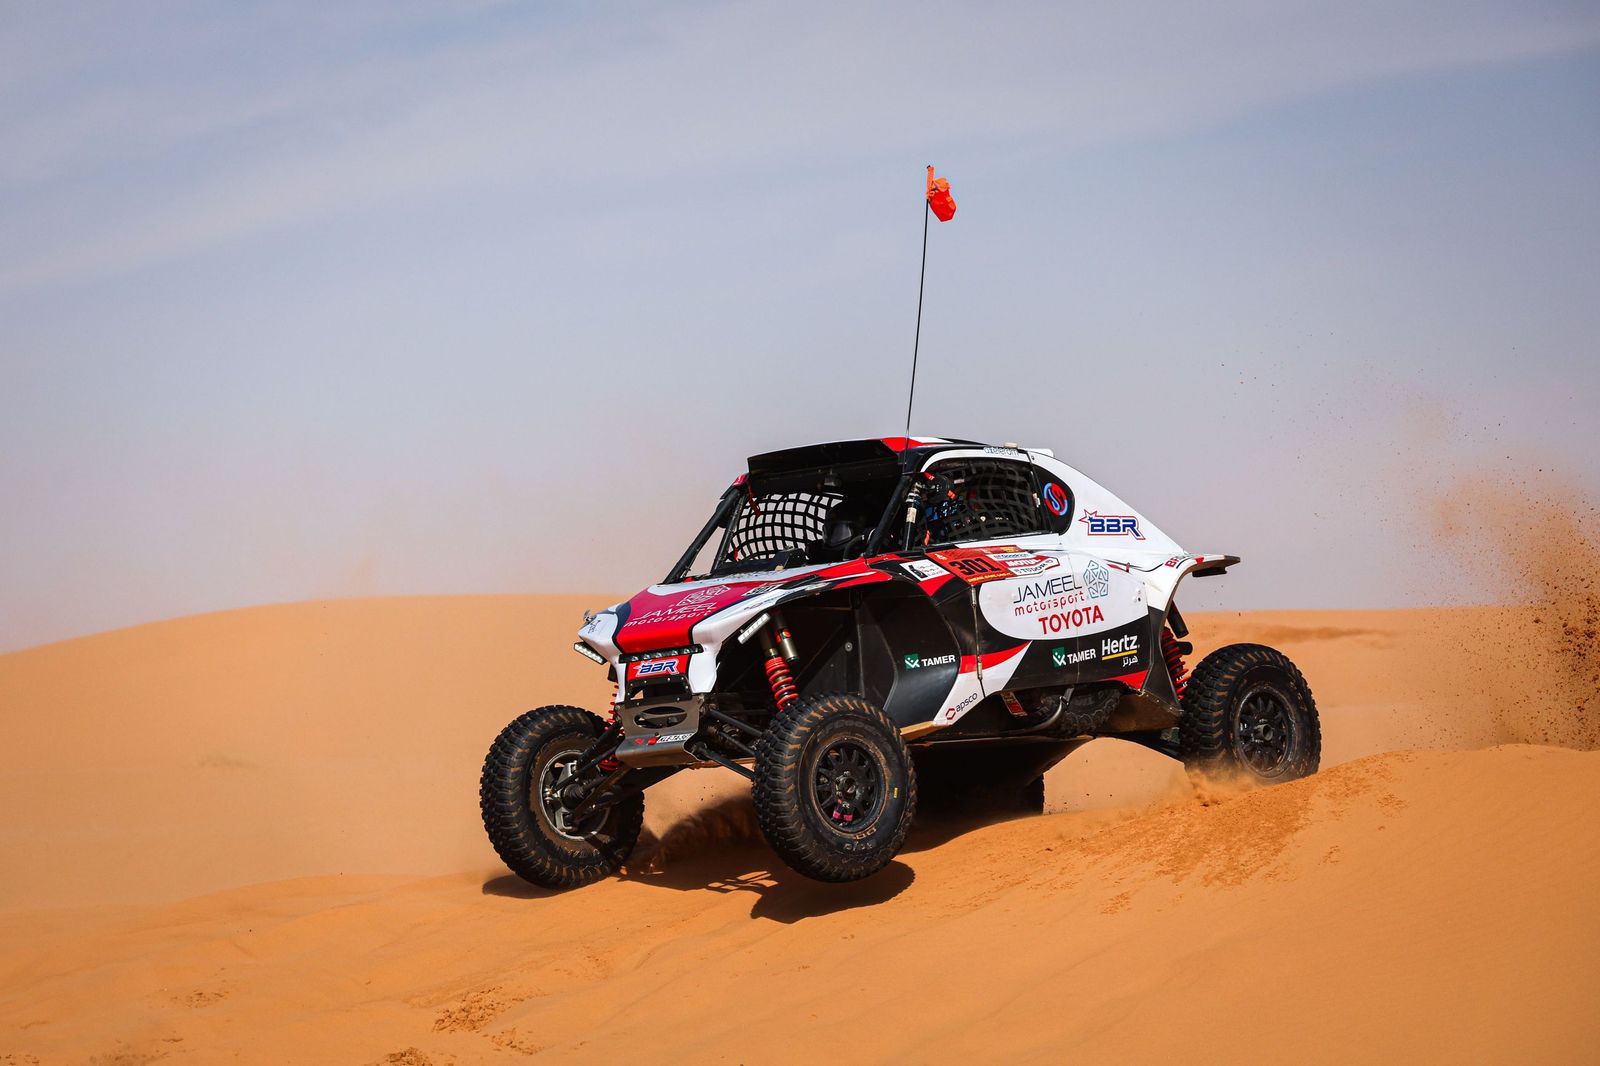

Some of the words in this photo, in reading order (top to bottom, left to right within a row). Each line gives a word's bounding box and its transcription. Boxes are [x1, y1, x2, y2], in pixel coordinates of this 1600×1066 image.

[1088, 517, 1141, 537] BBR
[950, 558, 1002, 575] 301
[1006, 558, 1041, 567] MOTUL
[1013, 574, 1083, 604] JAMEEL
[632, 602, 718, 621] JAMEEL
[1015, 591, 1085, 617] motorsport
[623, 609, 712, 628] motorsport
[1039, 605, 1105, 635] TOYOTA
[1101, 635, 1138, 656] Hertz
[921, 654, 956, 667] TAMER
[1067, 648, 1097, 665] TAMER
[639, 660, 677, 674] BBR
[955, 692, 978, 712] apsco
